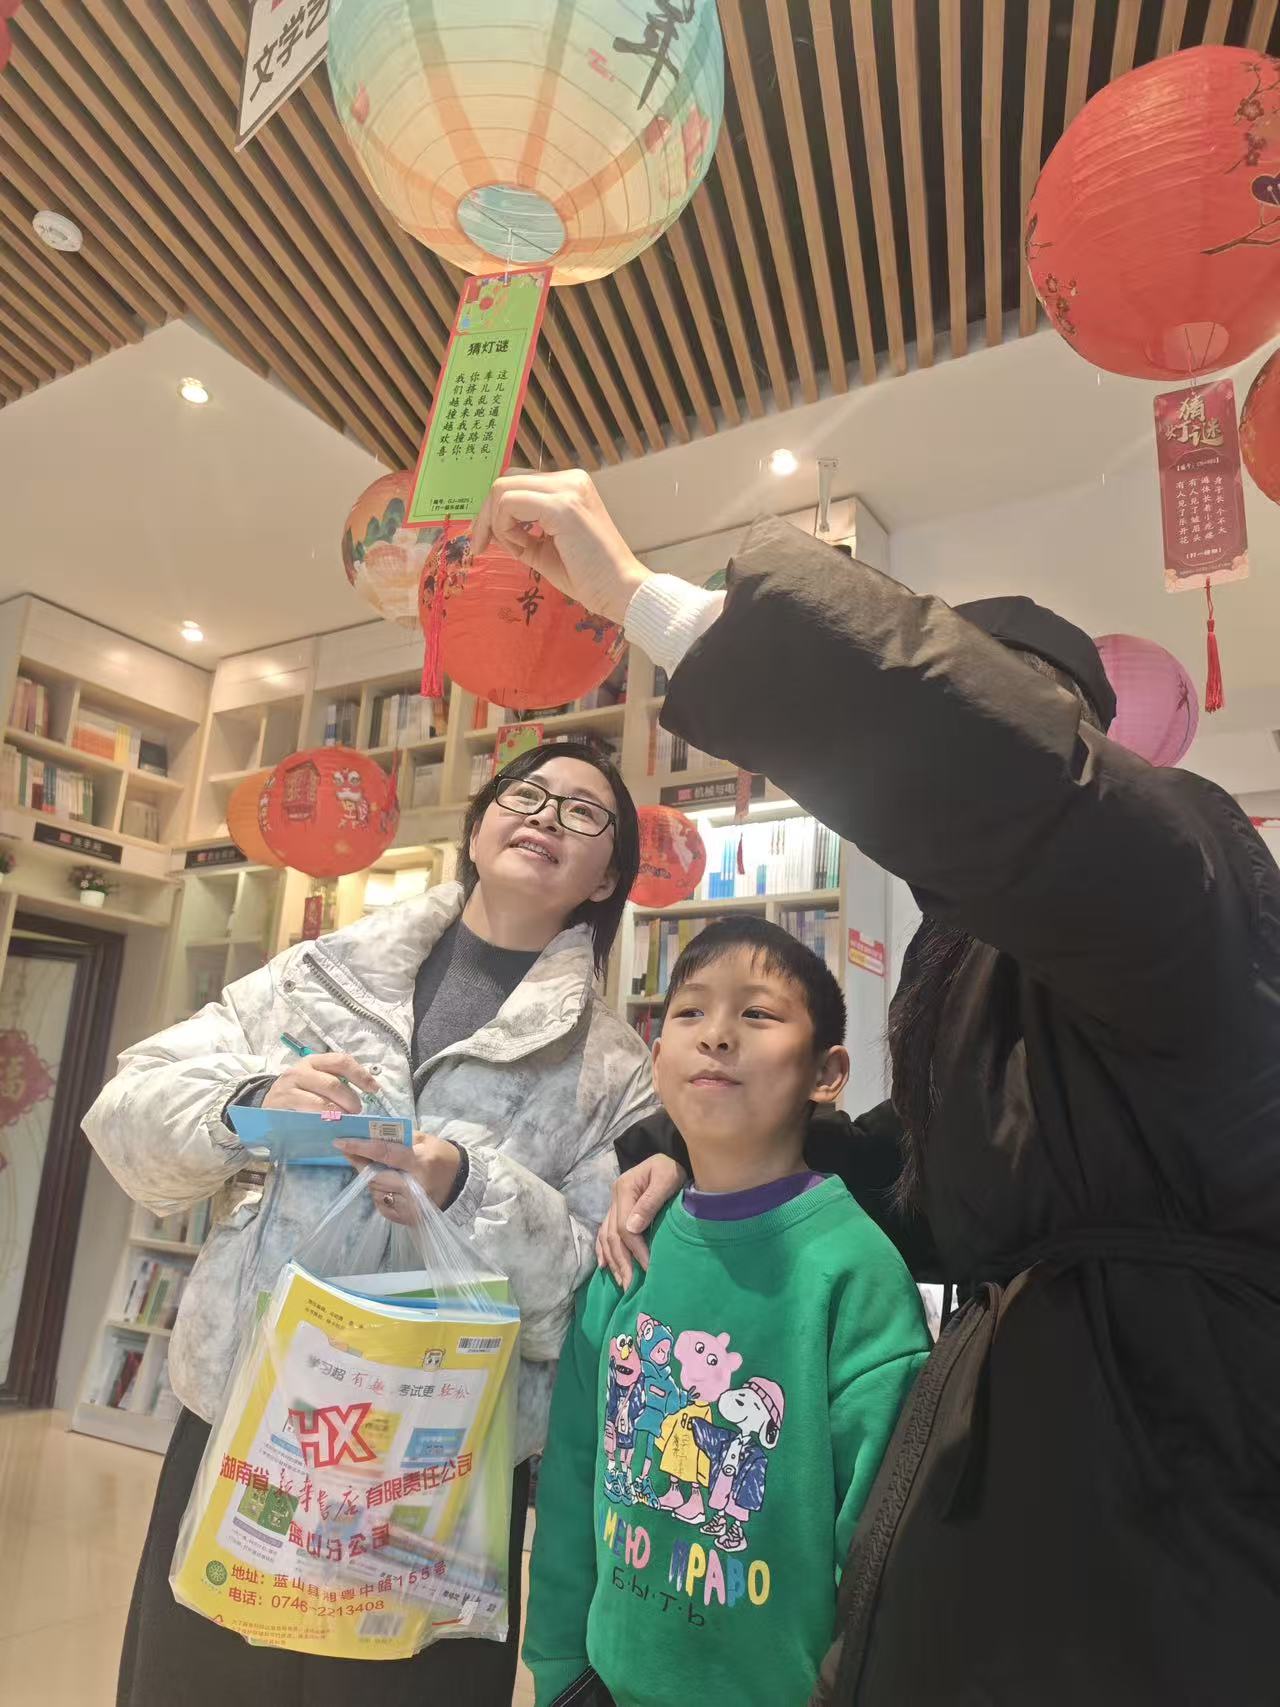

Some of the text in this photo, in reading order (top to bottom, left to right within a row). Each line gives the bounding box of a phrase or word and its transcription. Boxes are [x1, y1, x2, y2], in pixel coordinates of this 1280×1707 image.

[467, 340, 510, 357] 猜灯谜
[288, 1402, 378, 1468] HX
[288, 1520, 390, 1562] 蓝山分公司
[667, 1536, 771, 1608] ПРАВО
